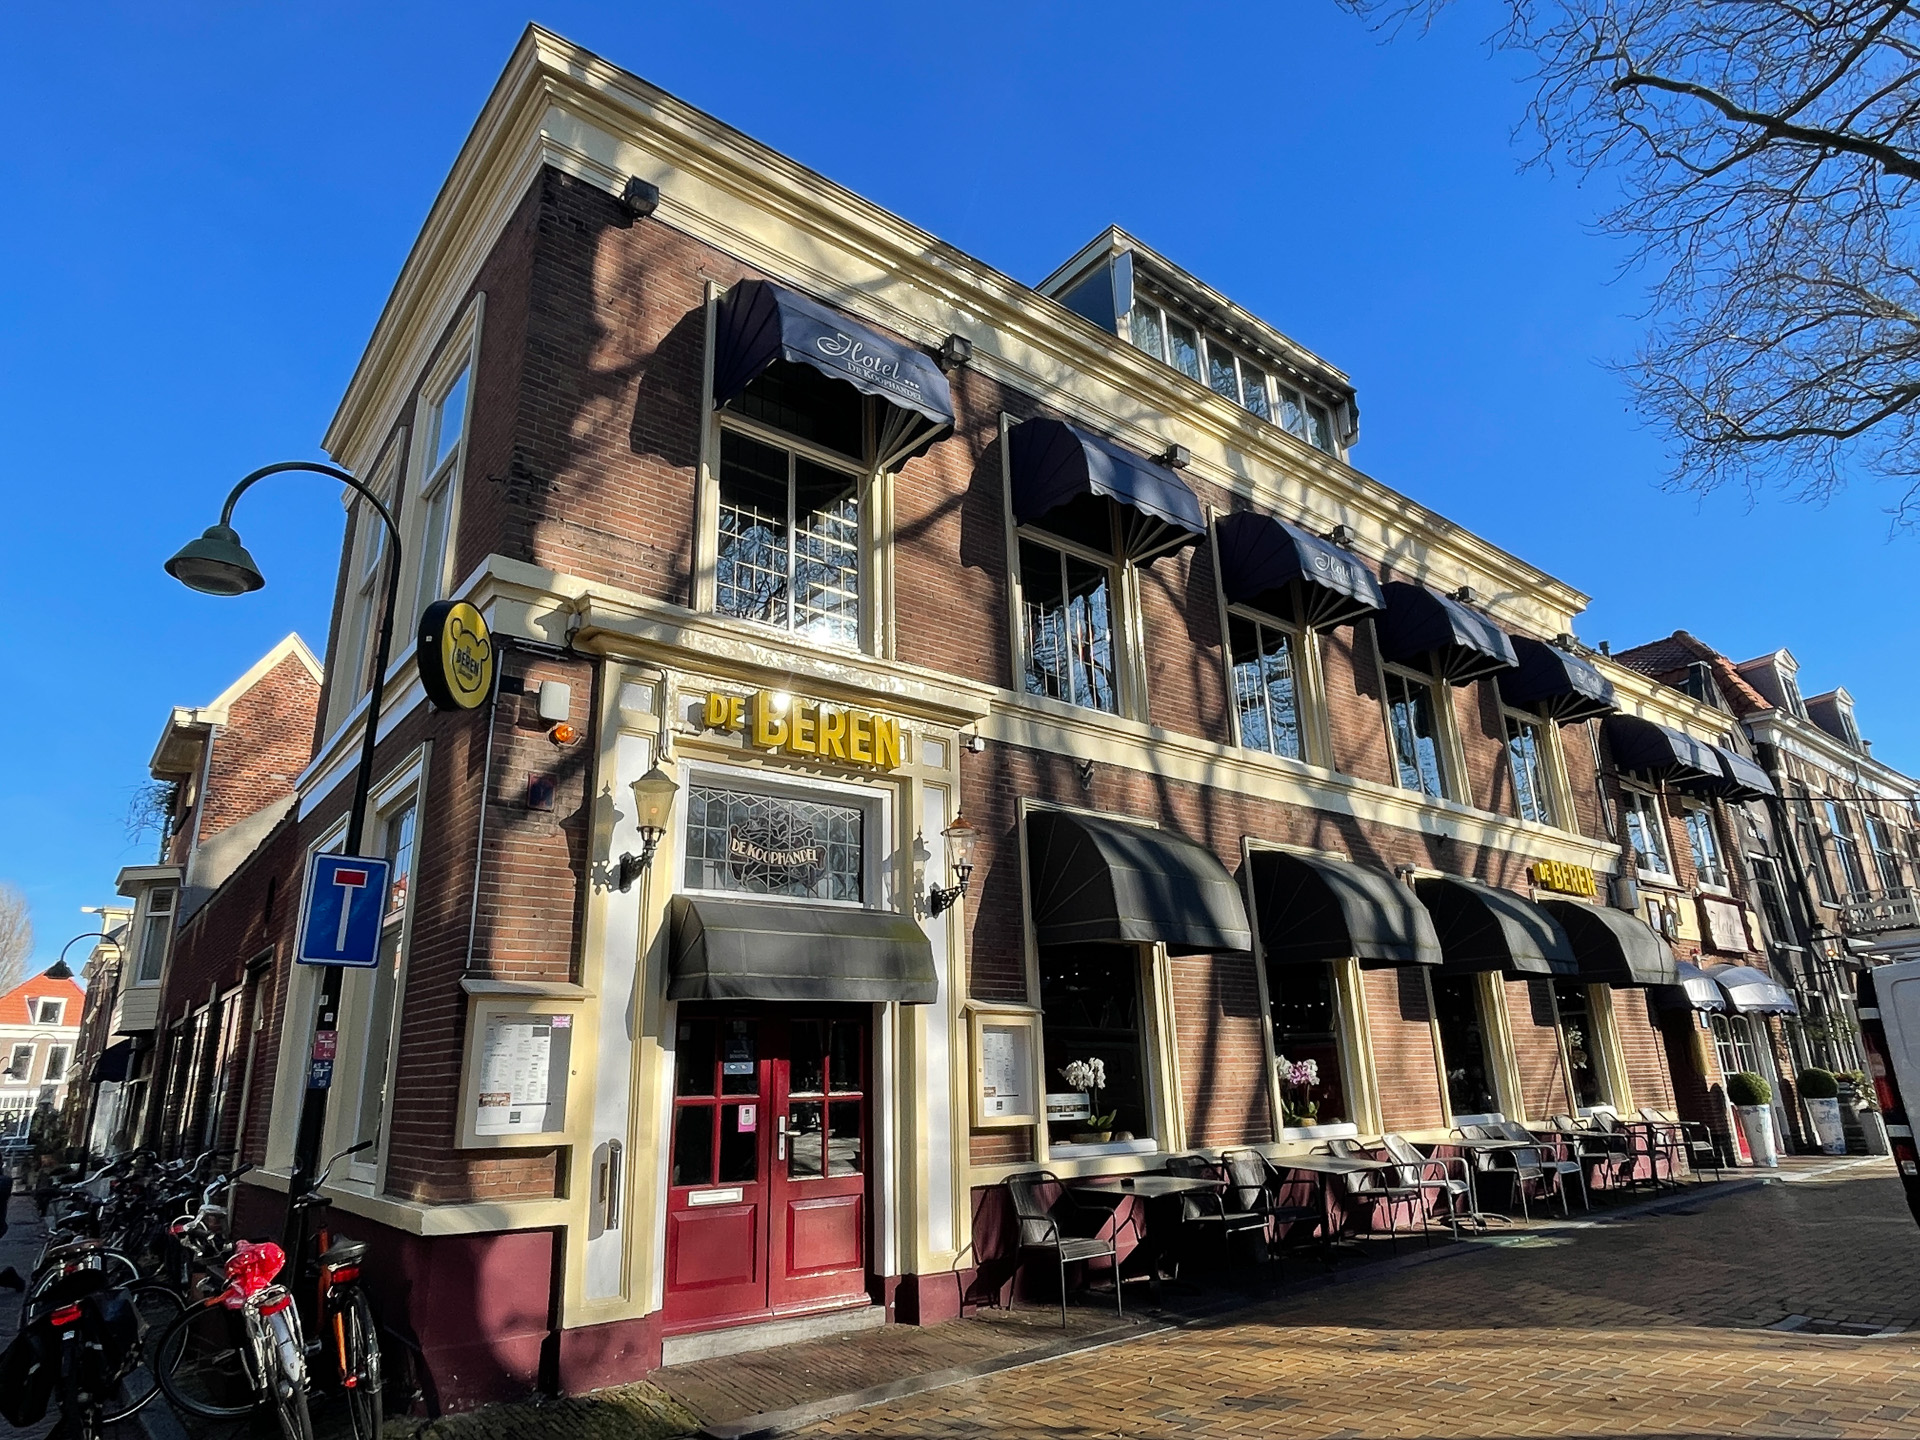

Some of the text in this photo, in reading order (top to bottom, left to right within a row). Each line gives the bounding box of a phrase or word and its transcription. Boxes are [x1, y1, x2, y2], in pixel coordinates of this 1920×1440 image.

[817, 333, 900, 379] Hotel
[706, 690, 900, 769] DE BEREN
[731, 838, 819, 865] DE KOOPHANDEL
[1538, 860, 1597, 896] DE BEREN
